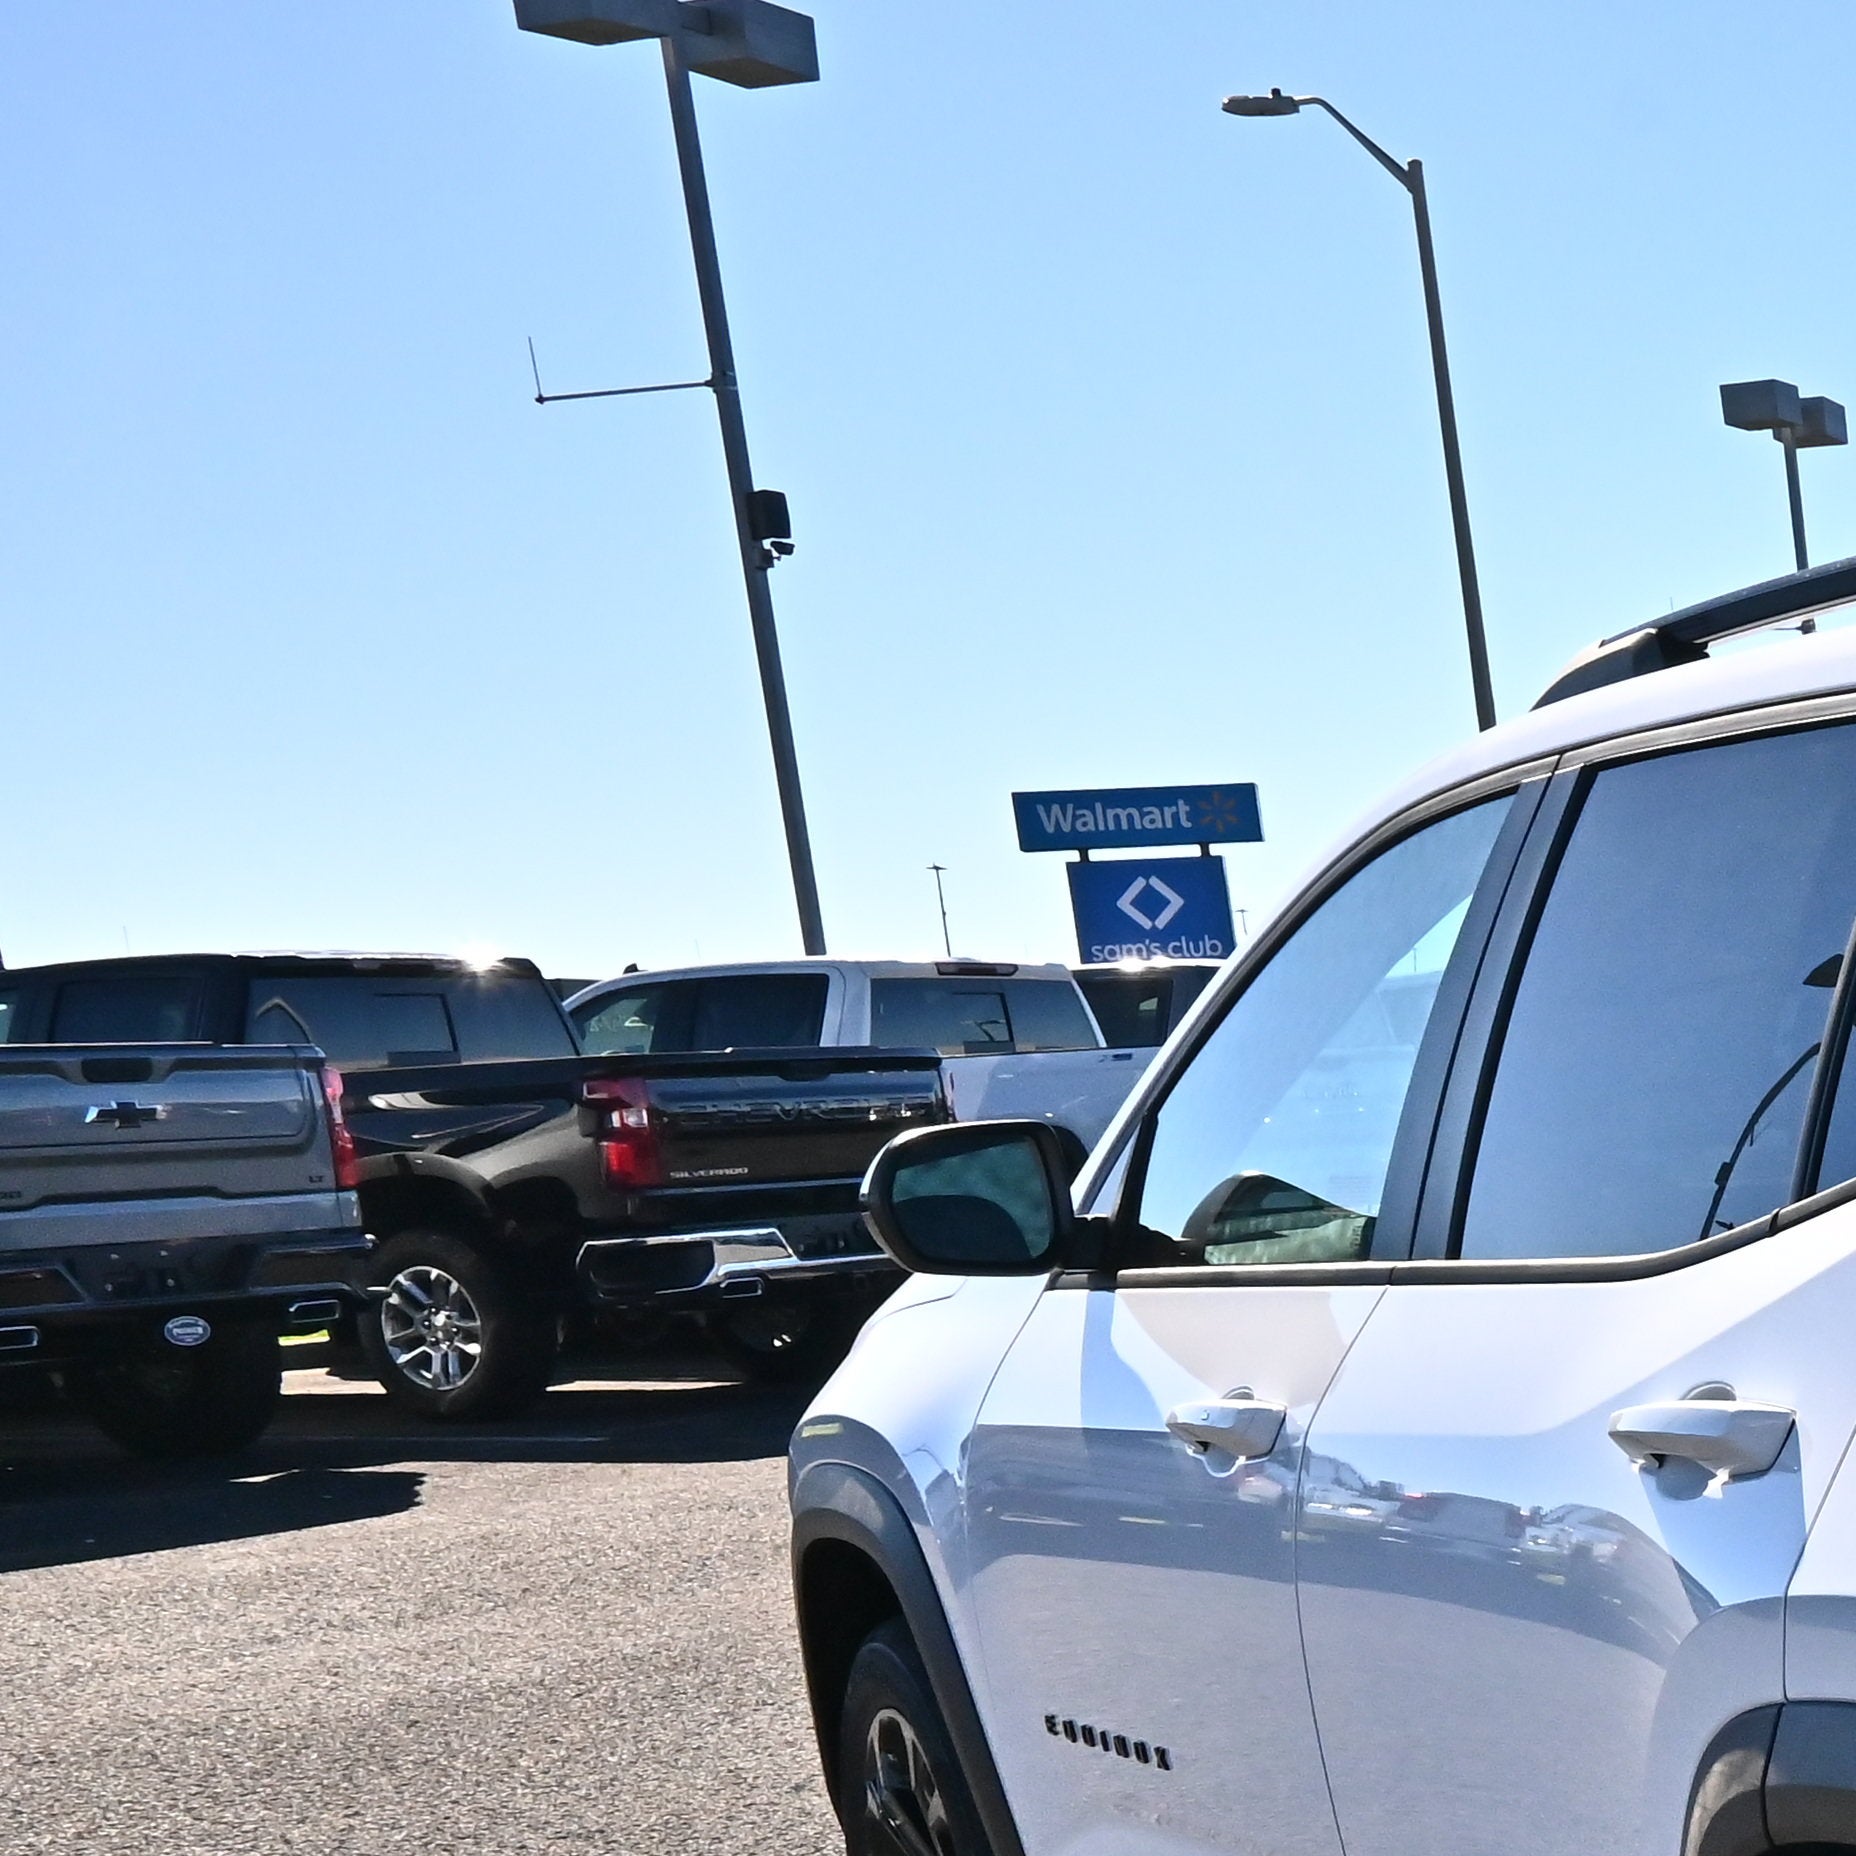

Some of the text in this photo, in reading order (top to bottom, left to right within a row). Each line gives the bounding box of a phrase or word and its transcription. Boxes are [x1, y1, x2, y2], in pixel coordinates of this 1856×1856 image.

[1035, 797, 1193, 835] Walmart
[1090, 934, 1223, 962] sam's club
[669, 1167, 749, 1179] SILVERADO
[1044, 1714, 1173, 1771] EQUINOX
